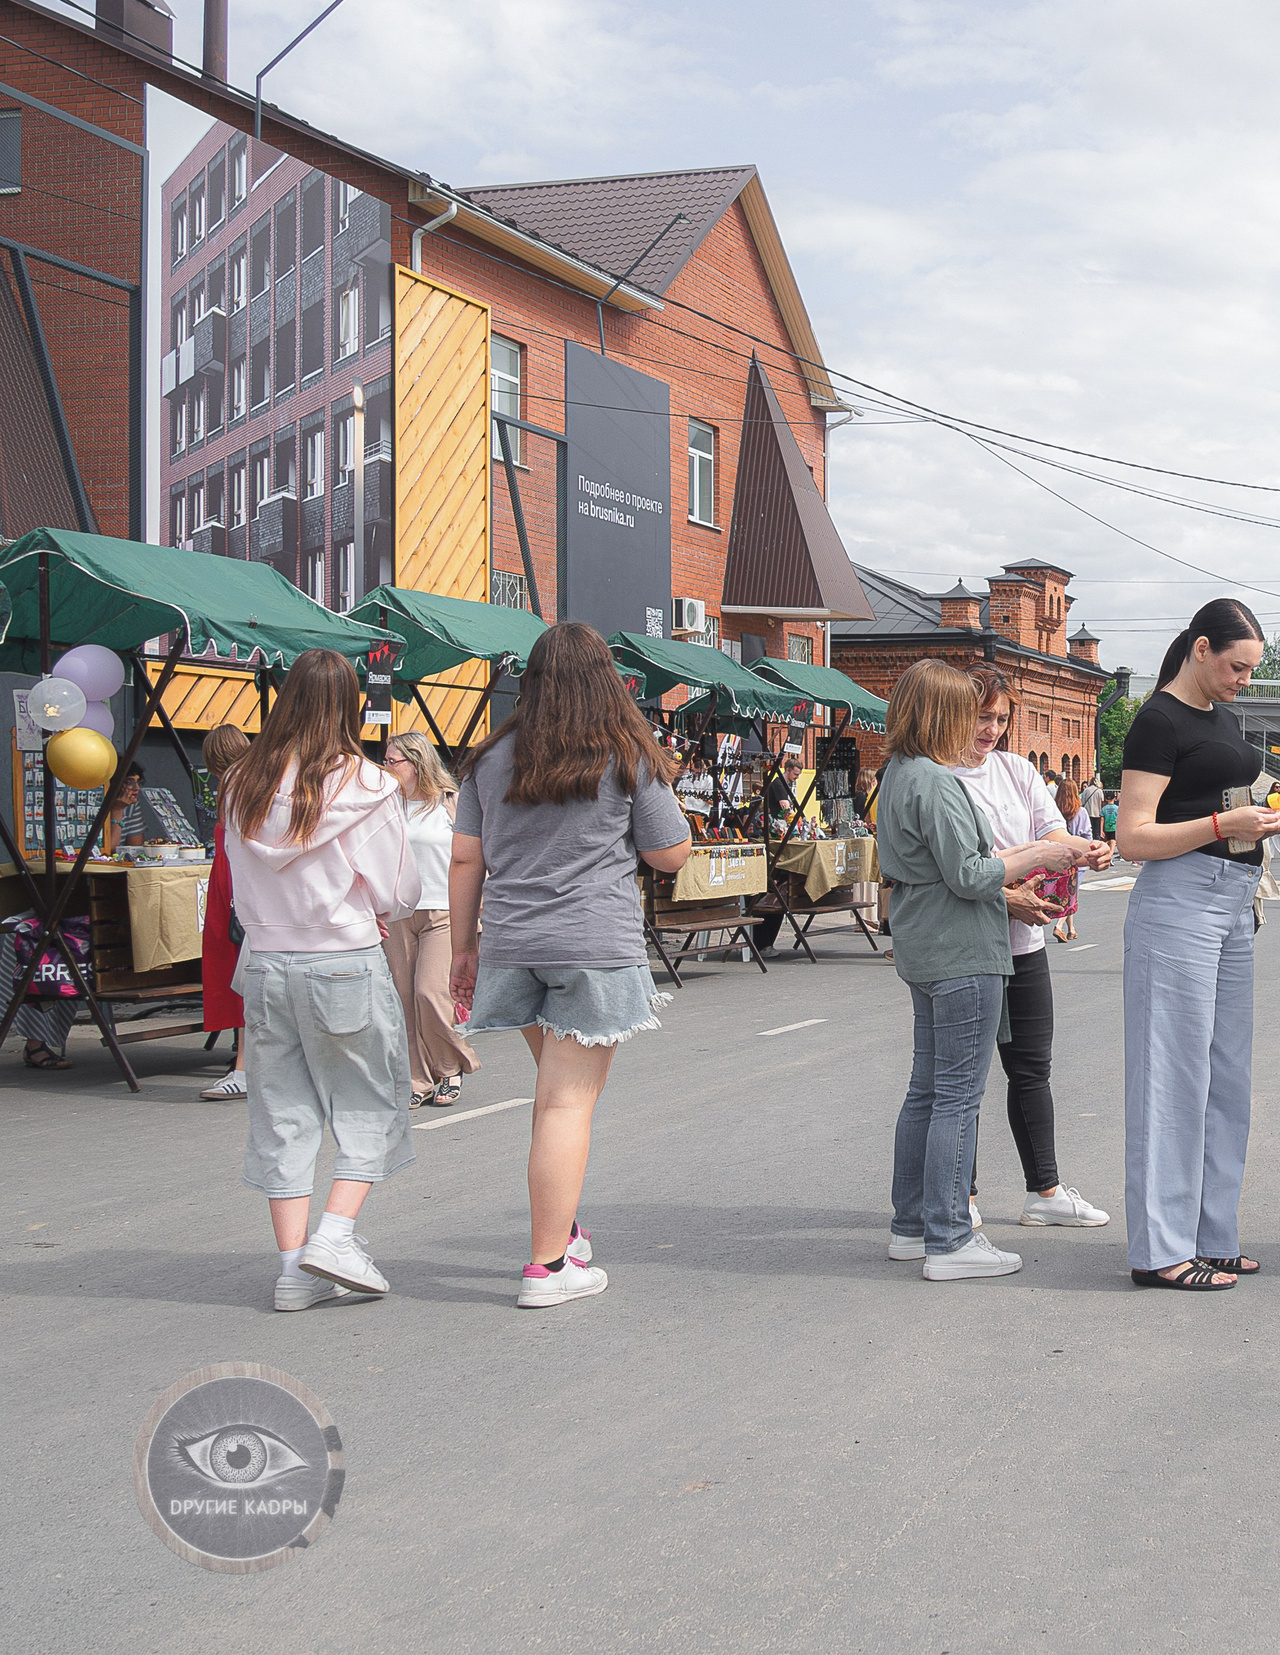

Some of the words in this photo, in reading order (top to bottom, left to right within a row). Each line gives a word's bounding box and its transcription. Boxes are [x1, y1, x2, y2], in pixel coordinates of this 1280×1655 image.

[578, 474, 625, 504] Подробнее
[625, 492, 631, 505] о
[631, 494, 663, 514] проекте
[578, 500, 590, 516] на
[590, 500, 635, 528] brusnika.ru
[367, 671, 392, 684] Ярмарка
